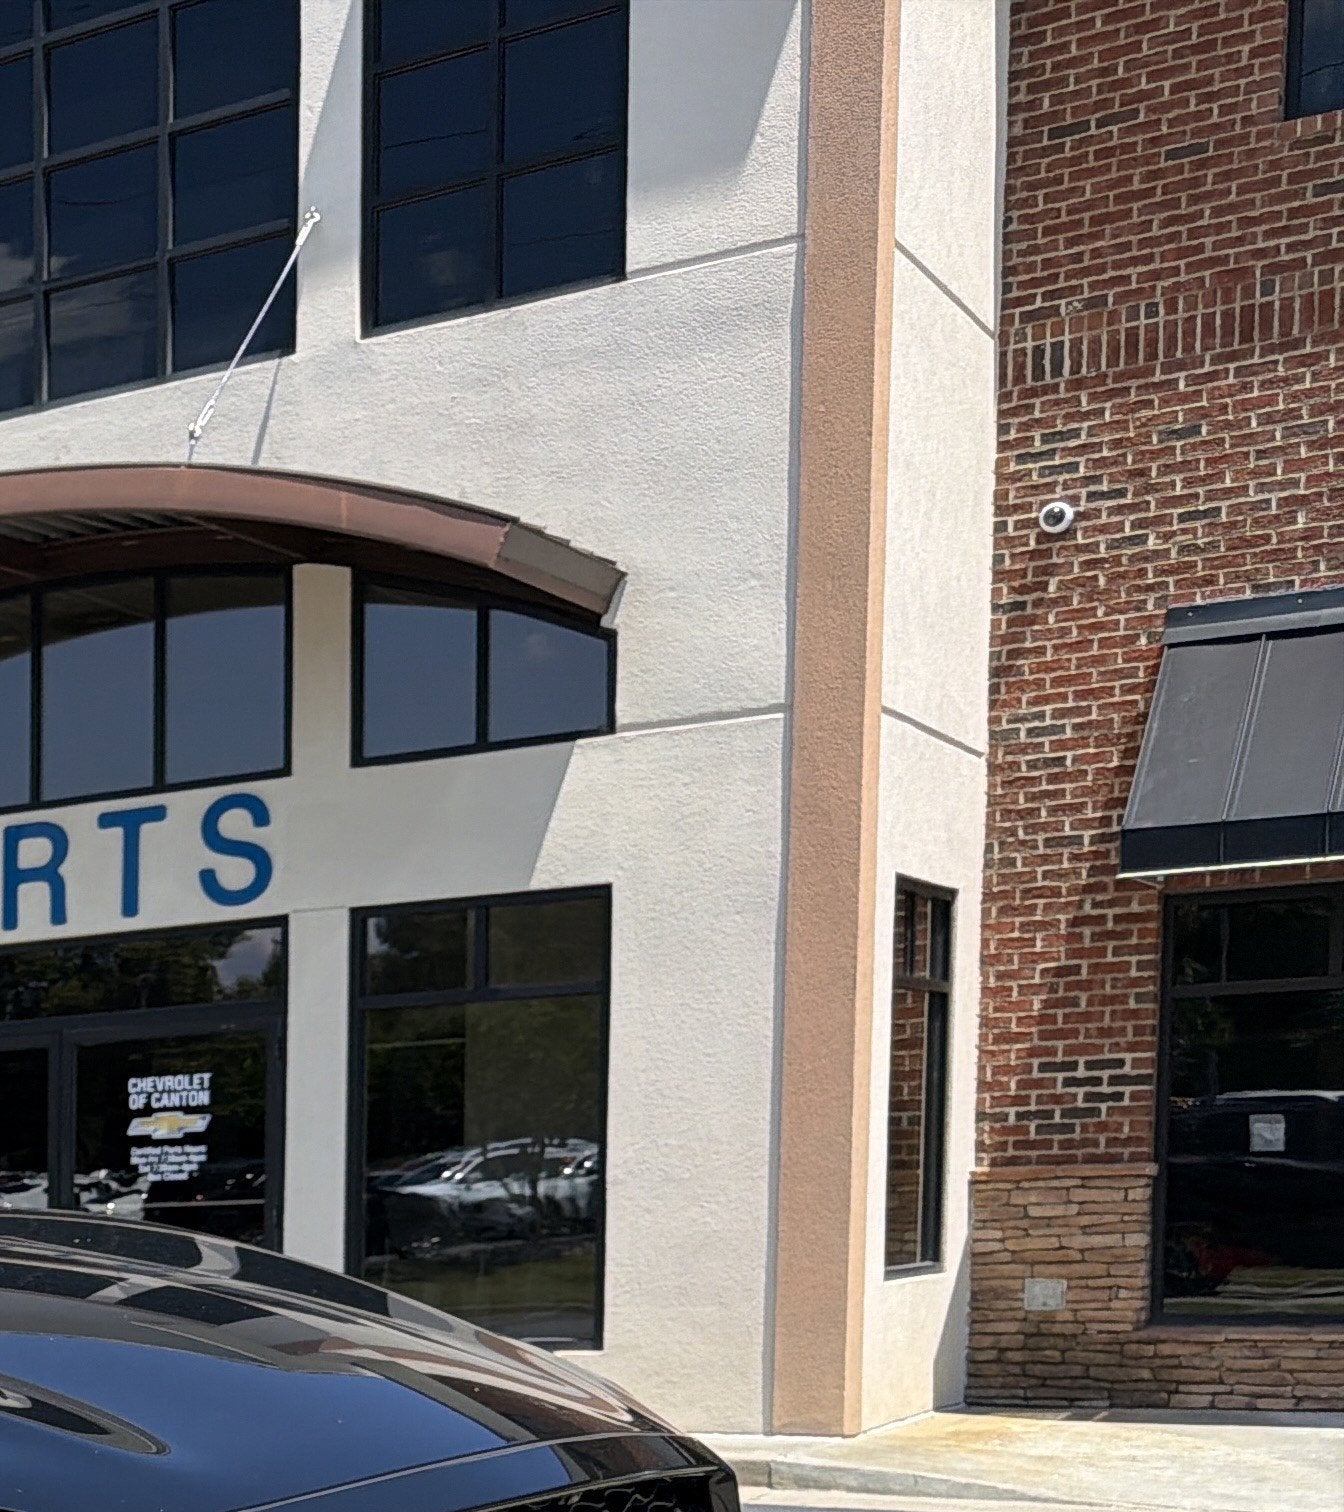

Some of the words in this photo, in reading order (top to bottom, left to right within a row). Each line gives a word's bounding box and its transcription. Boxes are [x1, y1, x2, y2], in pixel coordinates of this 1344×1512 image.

[127, 1072, 213, 1094] CHEVROLET
[128, 1093, 148, 1111] OF
[150, 1089, 211, 1109] CANTON
